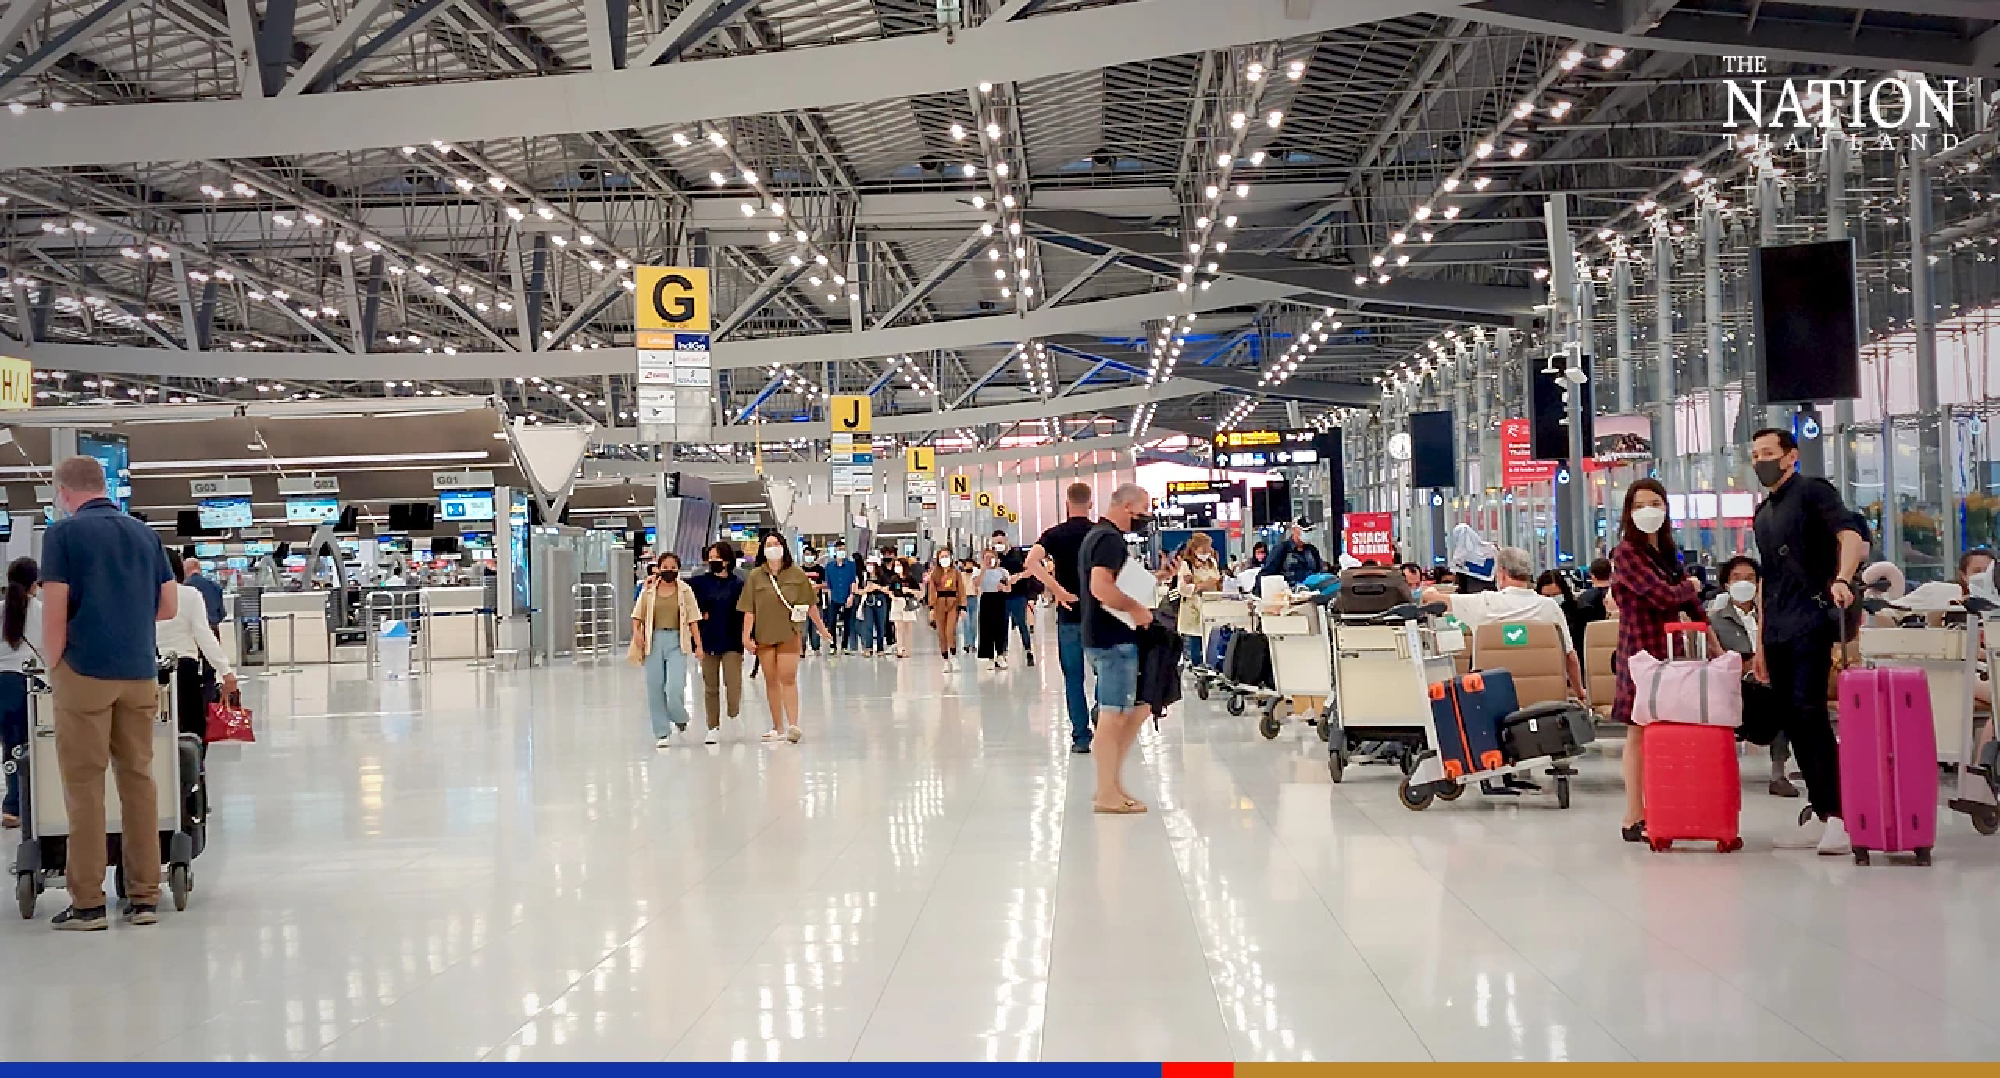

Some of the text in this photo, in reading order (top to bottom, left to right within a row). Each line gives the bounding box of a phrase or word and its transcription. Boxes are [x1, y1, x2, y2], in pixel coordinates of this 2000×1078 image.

[653, 274, 695, 323] G
[843, 399, 860, 428] J
[914, 449, 928, 470] L
[954, 476, 967, 493] N
[979, 493, 990, 507] Q
[996, 505, 1006, 517] S
[1351, 530, 1389, 544] SNACK
